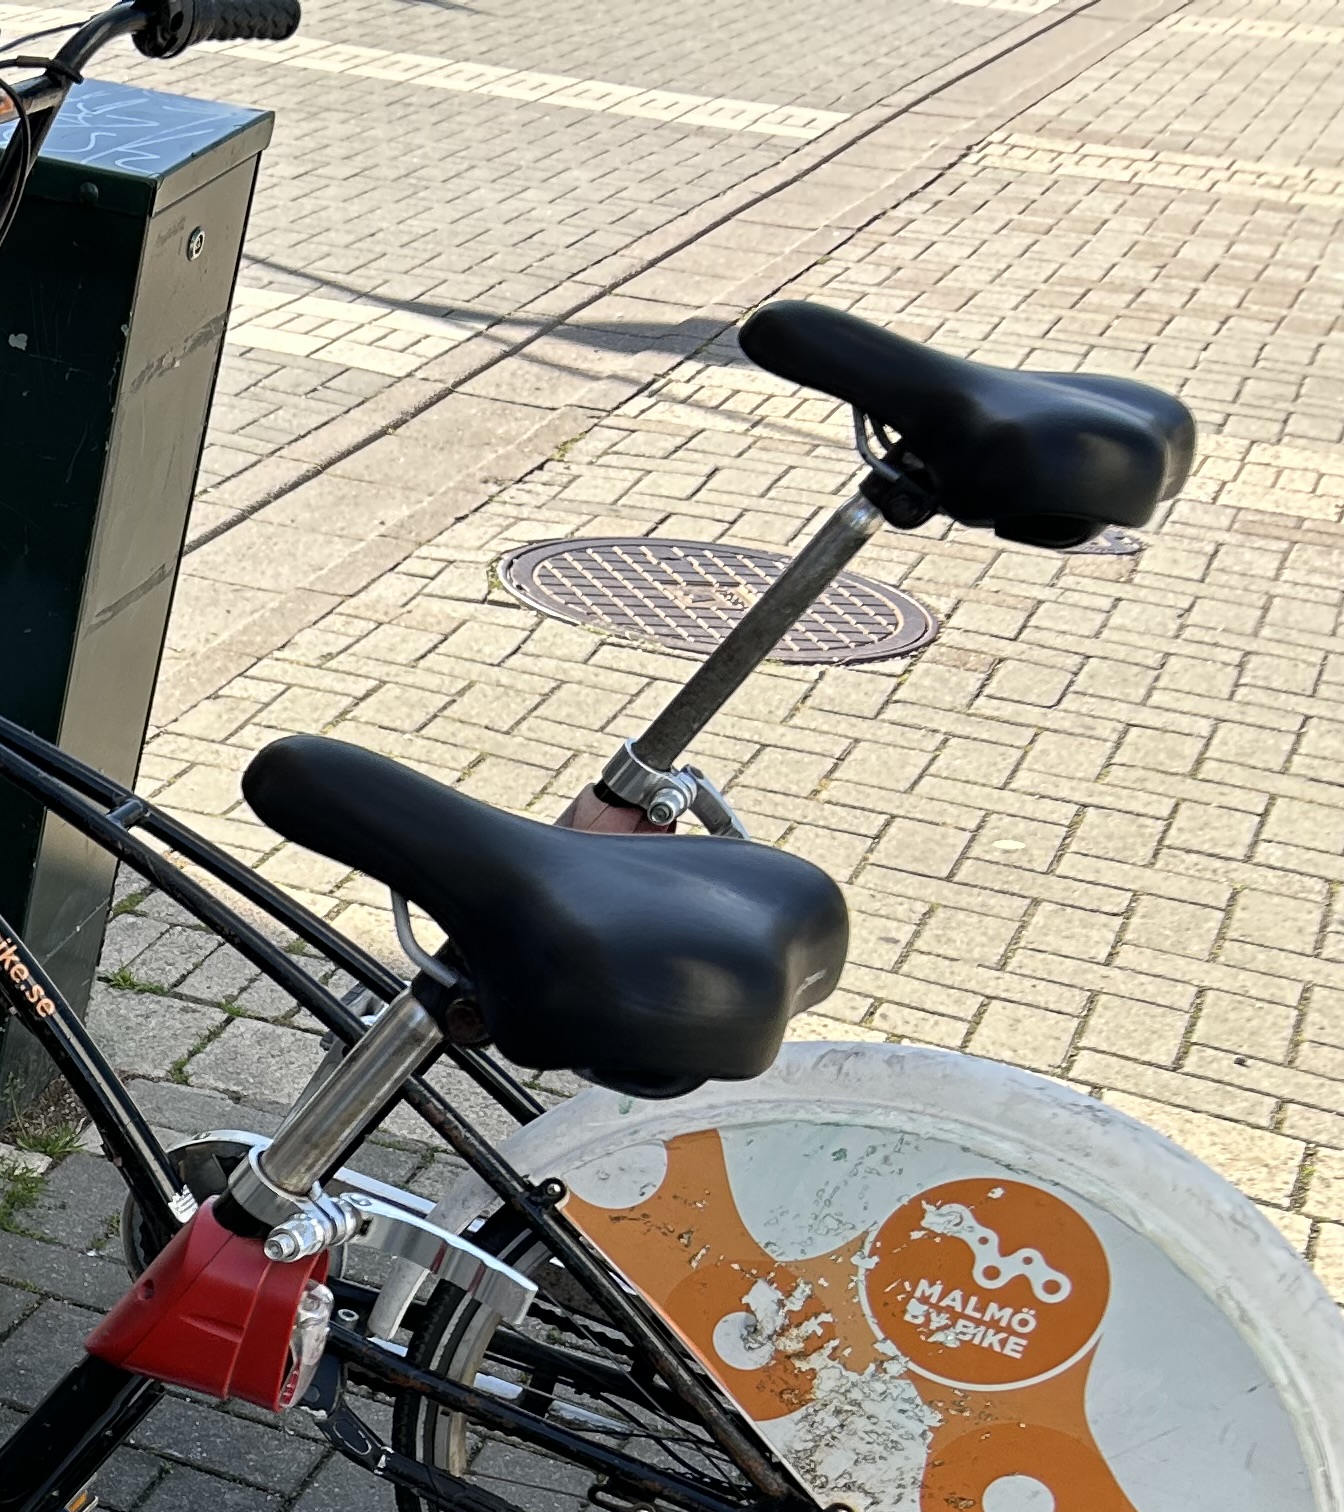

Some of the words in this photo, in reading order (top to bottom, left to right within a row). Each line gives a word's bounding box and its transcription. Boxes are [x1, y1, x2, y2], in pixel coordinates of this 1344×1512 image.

[903, 1298, 950, 1330] BY
[953, 1318, 1029, 1360] BIKE
[913, 1279, 1038, 1334] MALMÖ
